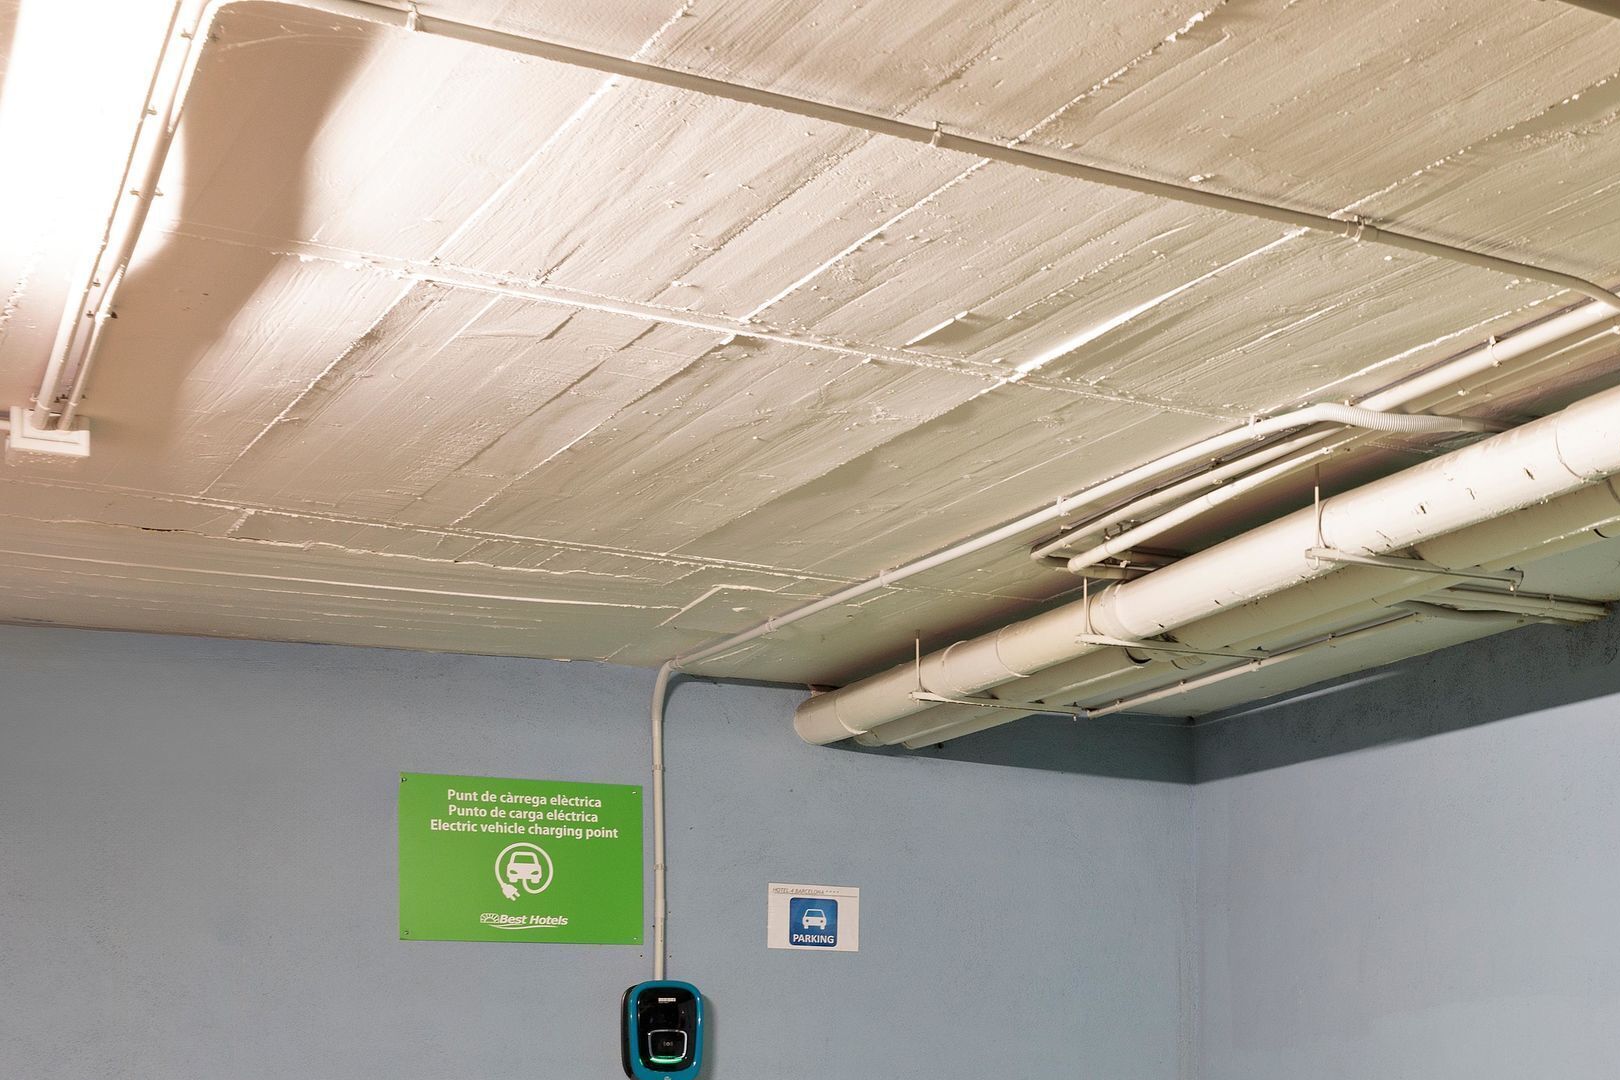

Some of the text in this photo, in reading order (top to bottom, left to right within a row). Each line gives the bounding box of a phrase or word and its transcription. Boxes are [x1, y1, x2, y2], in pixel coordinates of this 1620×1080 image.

[447, 788, 602, 808] Punt de càrrega elèctrica
[448, 804, 599, 823] Punto de carga eléctrica
[430, 818, 619, 840] Electric vehicle charging point
[499, 914, 569, 926] Best Hotels
[792, 933, 835, 944] PARKING
